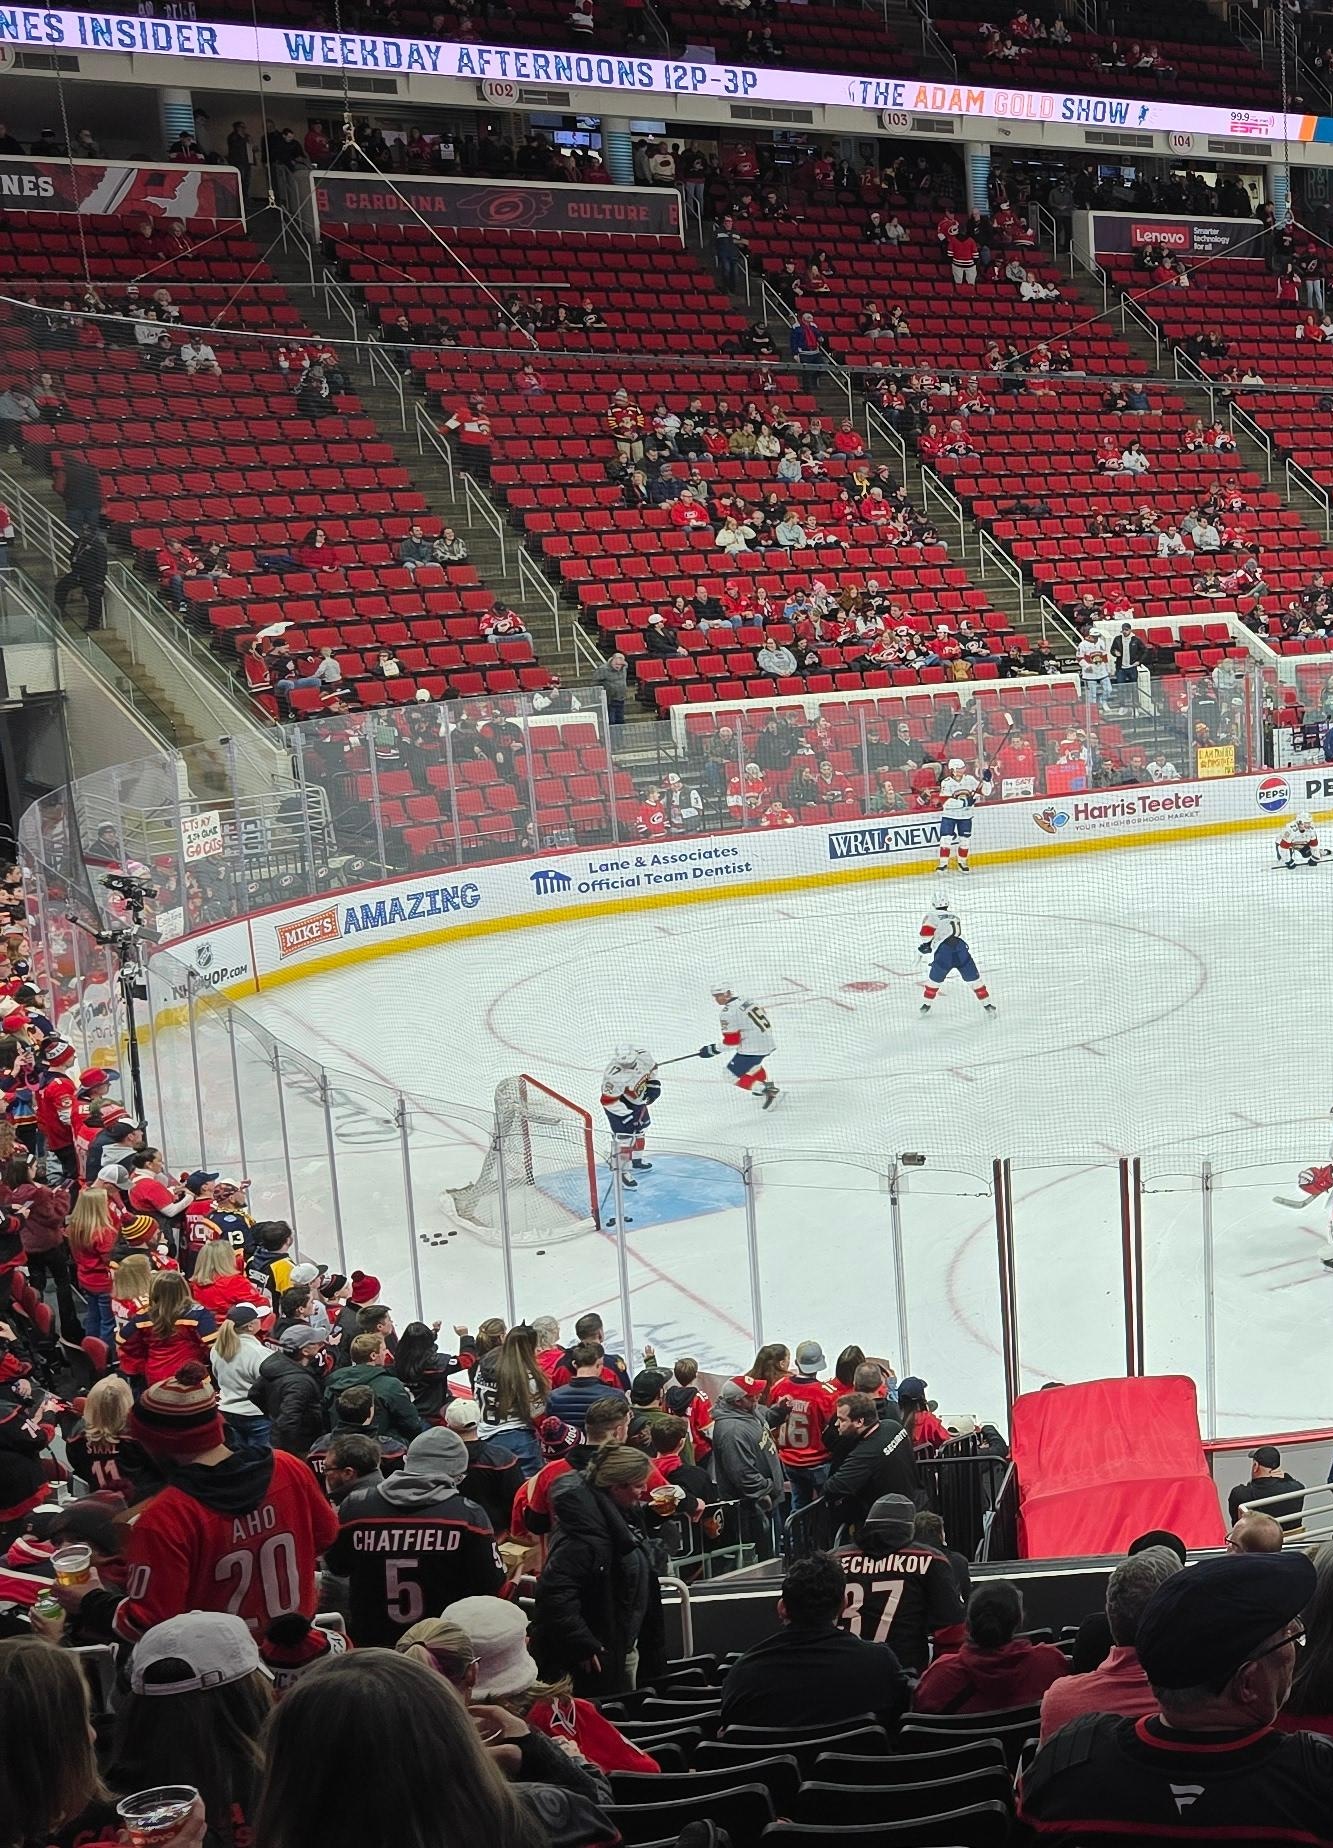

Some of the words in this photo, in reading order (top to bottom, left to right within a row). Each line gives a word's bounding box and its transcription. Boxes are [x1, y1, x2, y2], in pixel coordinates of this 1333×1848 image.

[79, 16, 221, 55] INSIDER
[284, 32, 443, 72] WEEKDAY
[457, 47, 654, 88] AFTERNOONS
[665, 66, 758, 95] 12P-3P
[488, 82, 514, 98] 102
[860, 80, 906, 107] THE
[915, 85, 984, 114] ADAM
[994, 91, 1054, 119] GOLD
[1062, 97, 1130, 125] SHOW
[887, 113, 908, 127] 103
[1230, 111, 1250, 122] 99.9
[1173, 135, 1190, 149] 104
[568, 204, 649, 222] CULTURE
[1135, 227, 1186, 247] Lenovo
[1194, 227, 1219, 237] Smarter
[1194, 234, 1230, 246] technology
[1194, 242, 1205, 251] for
[1074, 800, 1136, 823] Harris
[1137, 792, 1203, 814] Teeter
[1258, 788, 1290, 801] PEPSI
[1075, 822, 1097, 832] YOUR
[1099, 814, 1167, 830] NEIGHBORHOOD
[1168, 810, 1201, 822] MARKET
[830, 831, 887, 859] WRAL
[589, 857, 631, 875] Lane
[634, 855, 647, 868] &
[650, 844, 739, 866] Associates
[577, 874, 641, 894] Official
[645, 867, 689, 887] Team
[692, 861, 752, 879] Dentist
[343, 882, 481, 935] AMAZING
[285, 919, 333, 949] MIKE'S
[232, 1507, 277, 1545] AHO
[353, 1529, 461, 1553] CHATFIELD
[214, 1532, 301, 1630] 20
[386, 1558, 424, 1624] 5
